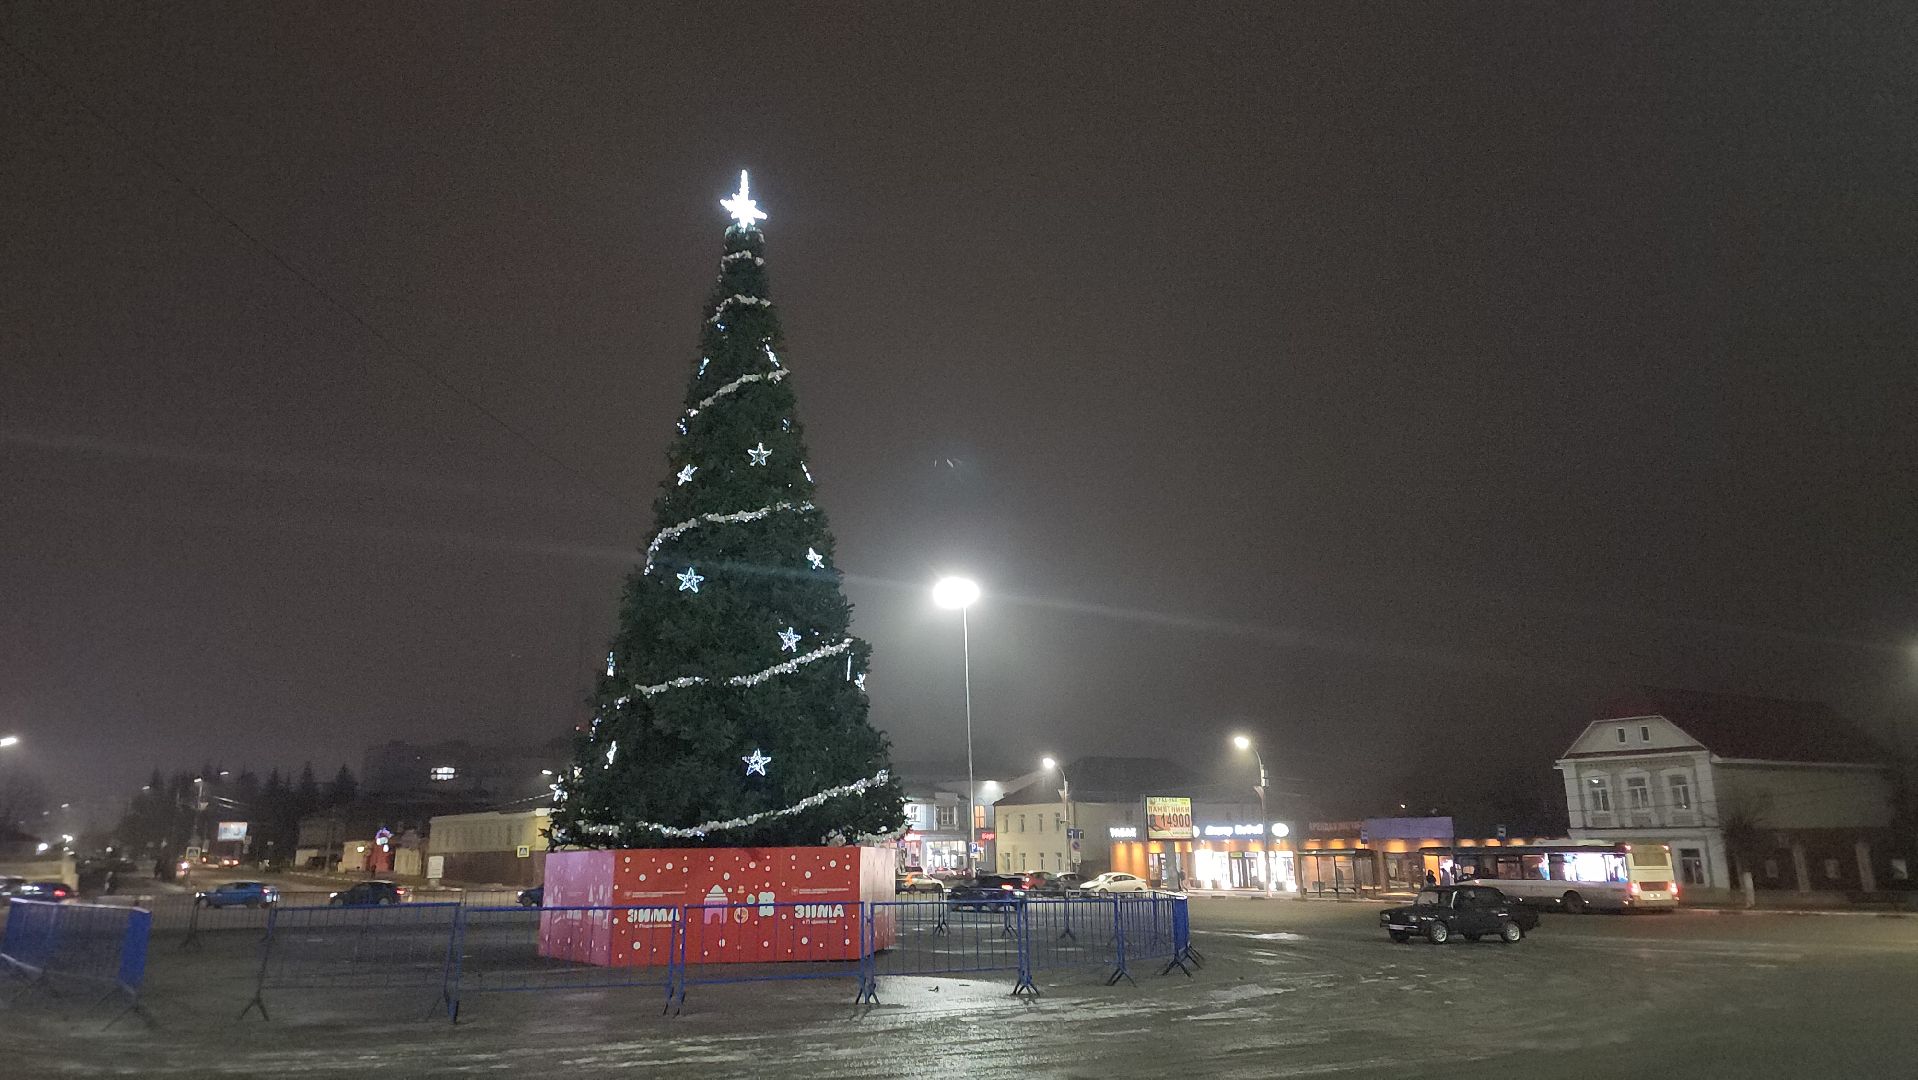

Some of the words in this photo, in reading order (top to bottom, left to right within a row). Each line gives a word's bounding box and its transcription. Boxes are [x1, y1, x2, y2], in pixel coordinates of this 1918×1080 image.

[1161, 813, 1190, 827] 14900
[627, 908, 680, 922] ЗИМА
[794, 904, 845, 919] ЗИМА
